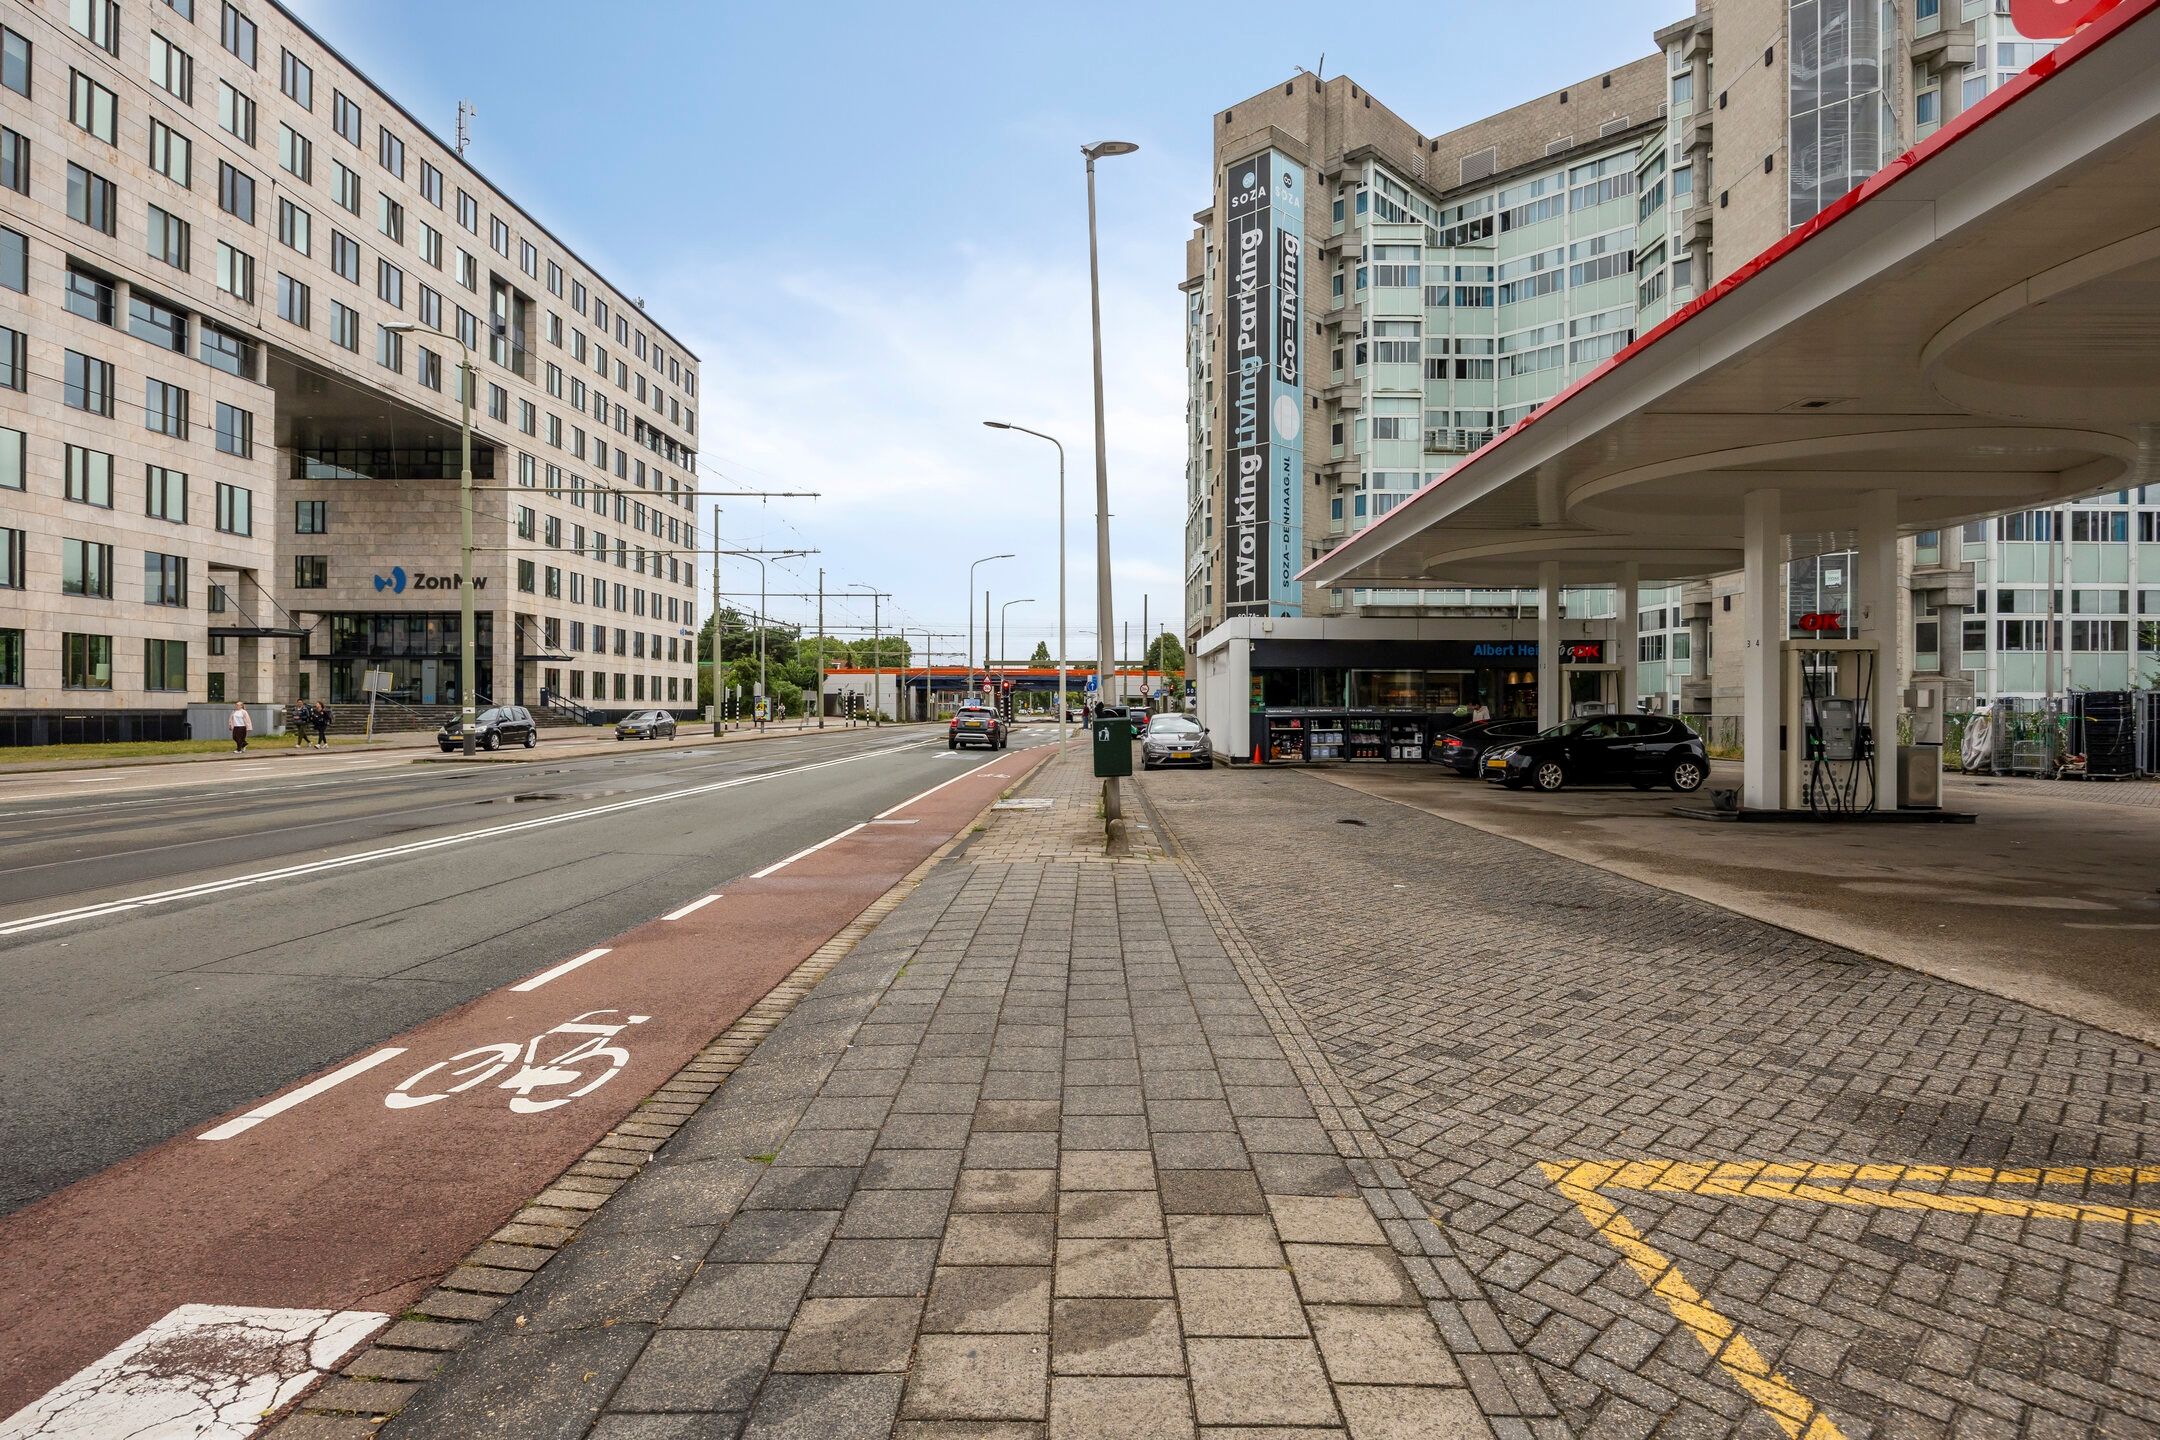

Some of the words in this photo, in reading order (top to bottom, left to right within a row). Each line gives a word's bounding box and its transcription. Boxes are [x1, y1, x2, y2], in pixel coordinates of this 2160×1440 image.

[1231, 186, 1266, 208] SOZA
[1275, 186, 1300, 208] SOZA
[1235, 228, 1263, 351] Parking
[1281, 233, 1300, 380] Co-living
[1235, 355, 1263, 448] Living
[1234, 454, 1263, 587] Working
[1282, 456, 1291, 588] SOZA-DENHAAG.NL
[1473, 644, 1514, 657] Albert
[1517, 644, 1539, 657] Hei
[1798, 613, 1842, 631] OK
[1573, 645, 1600, 657] OK
